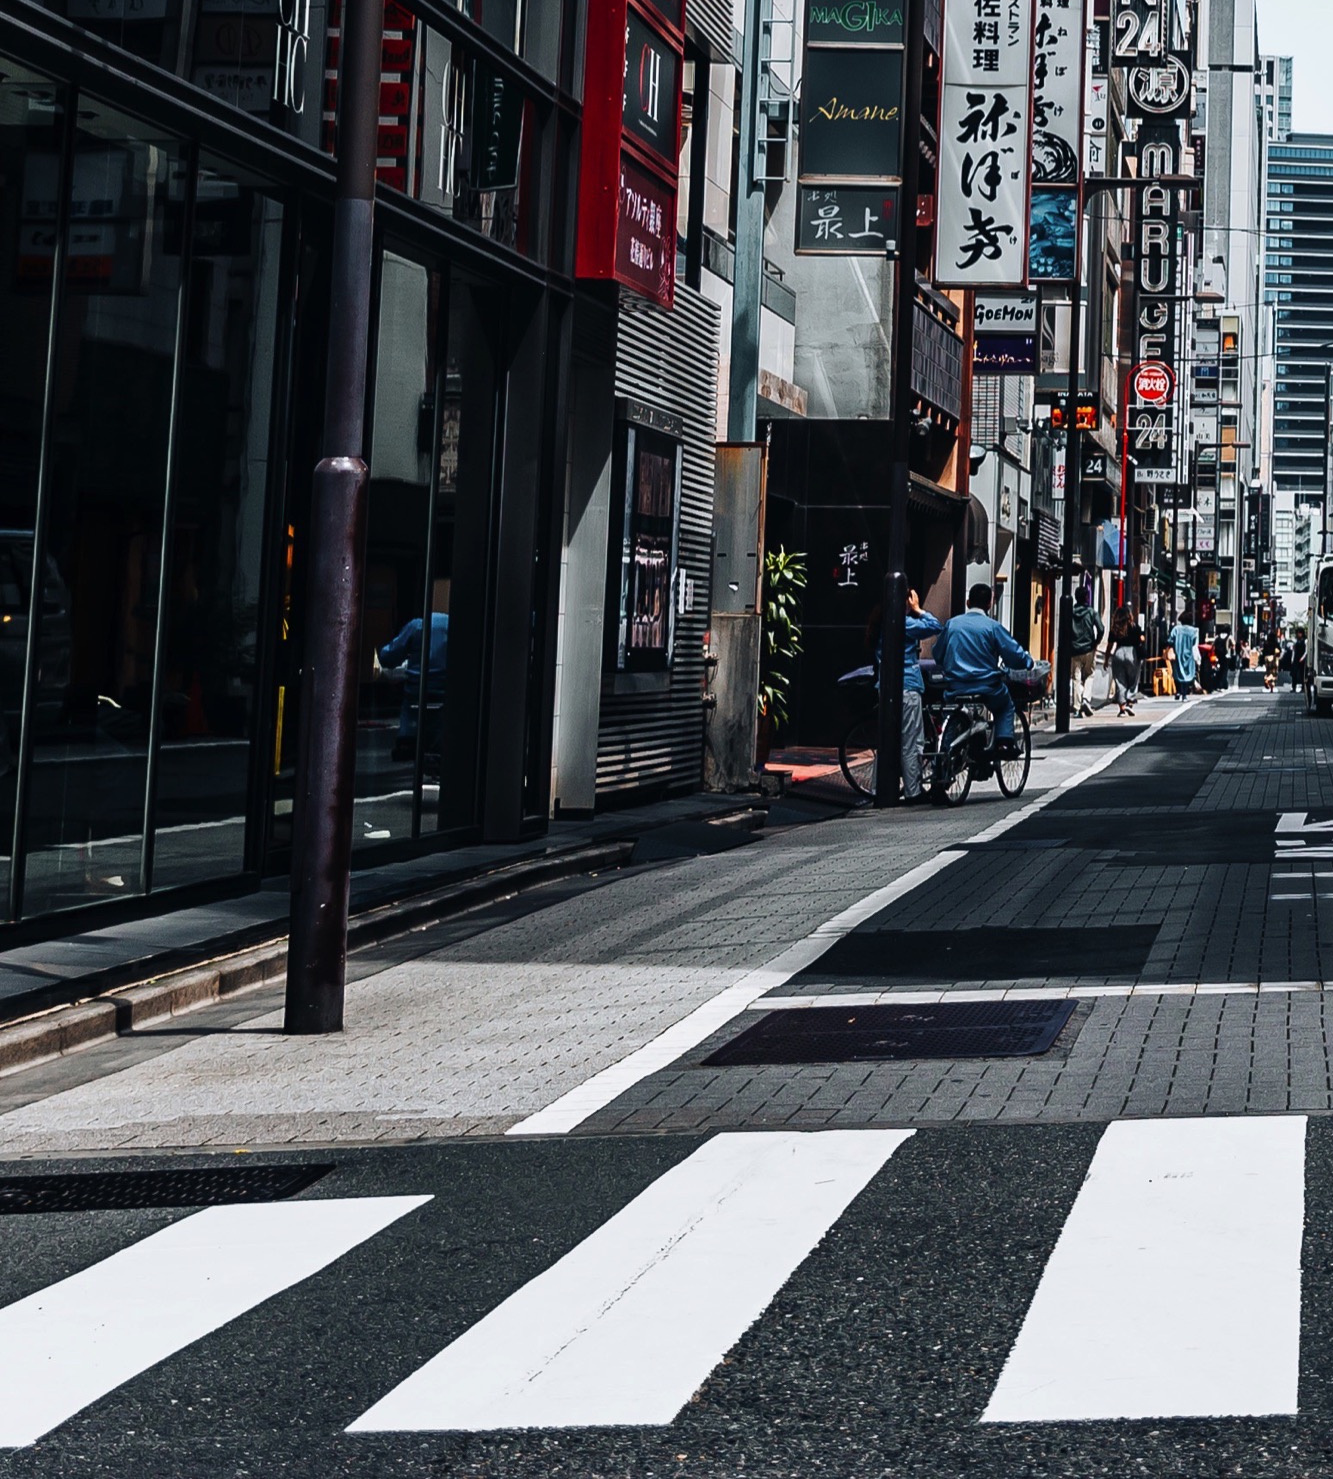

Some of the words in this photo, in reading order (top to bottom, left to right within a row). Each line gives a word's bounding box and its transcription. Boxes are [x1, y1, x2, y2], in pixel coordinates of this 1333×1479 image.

[809, 0, 903, 33] MAGIKA
[810, 205, 885, 241] 最上
[1137, 376, 1166, 392] 消火栓
[1085, 458, 1103, 474] 24
